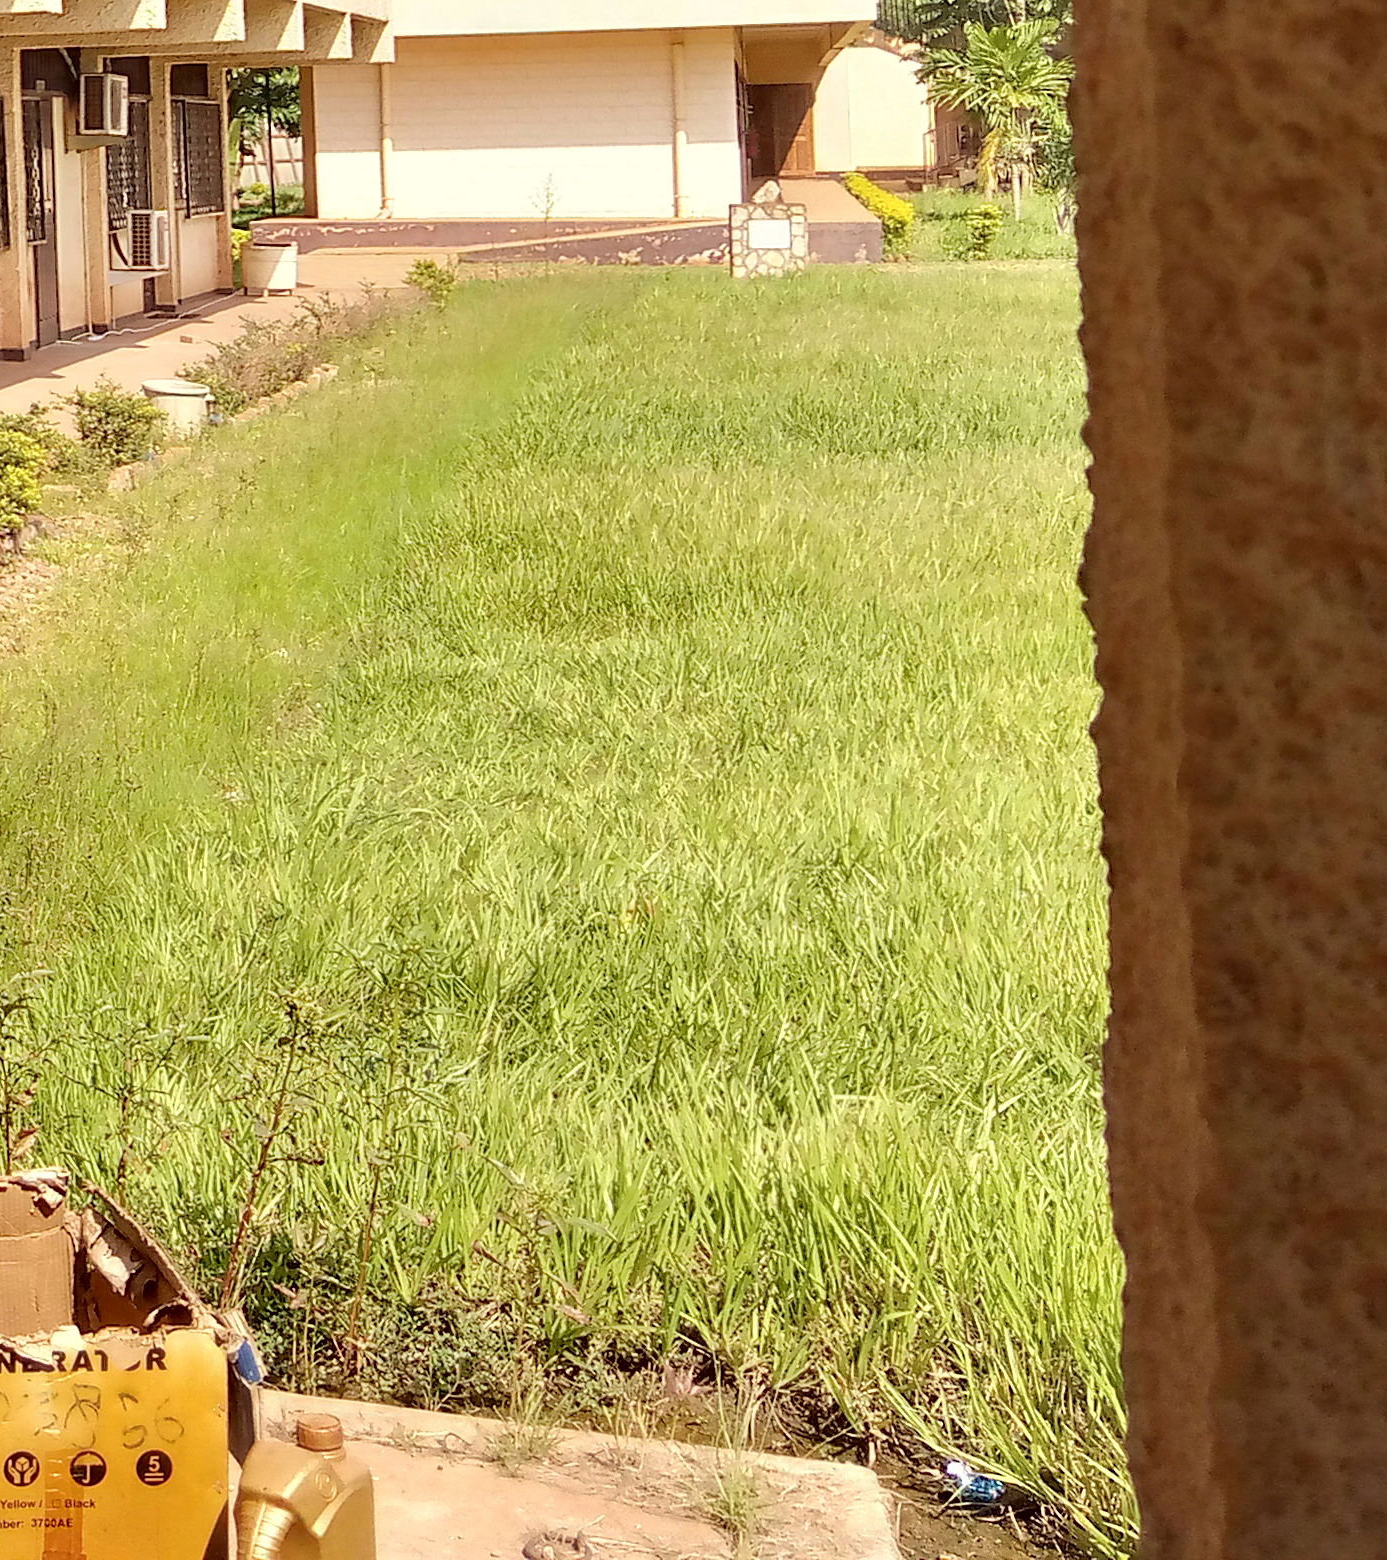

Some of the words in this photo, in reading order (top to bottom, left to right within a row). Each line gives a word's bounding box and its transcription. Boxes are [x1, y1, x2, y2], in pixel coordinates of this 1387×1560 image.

[0, 1499, 36, 1509] Yellow
[64, 1498, 96, 1508] Black
[31, 1518, 73, 1528] 3700AE
